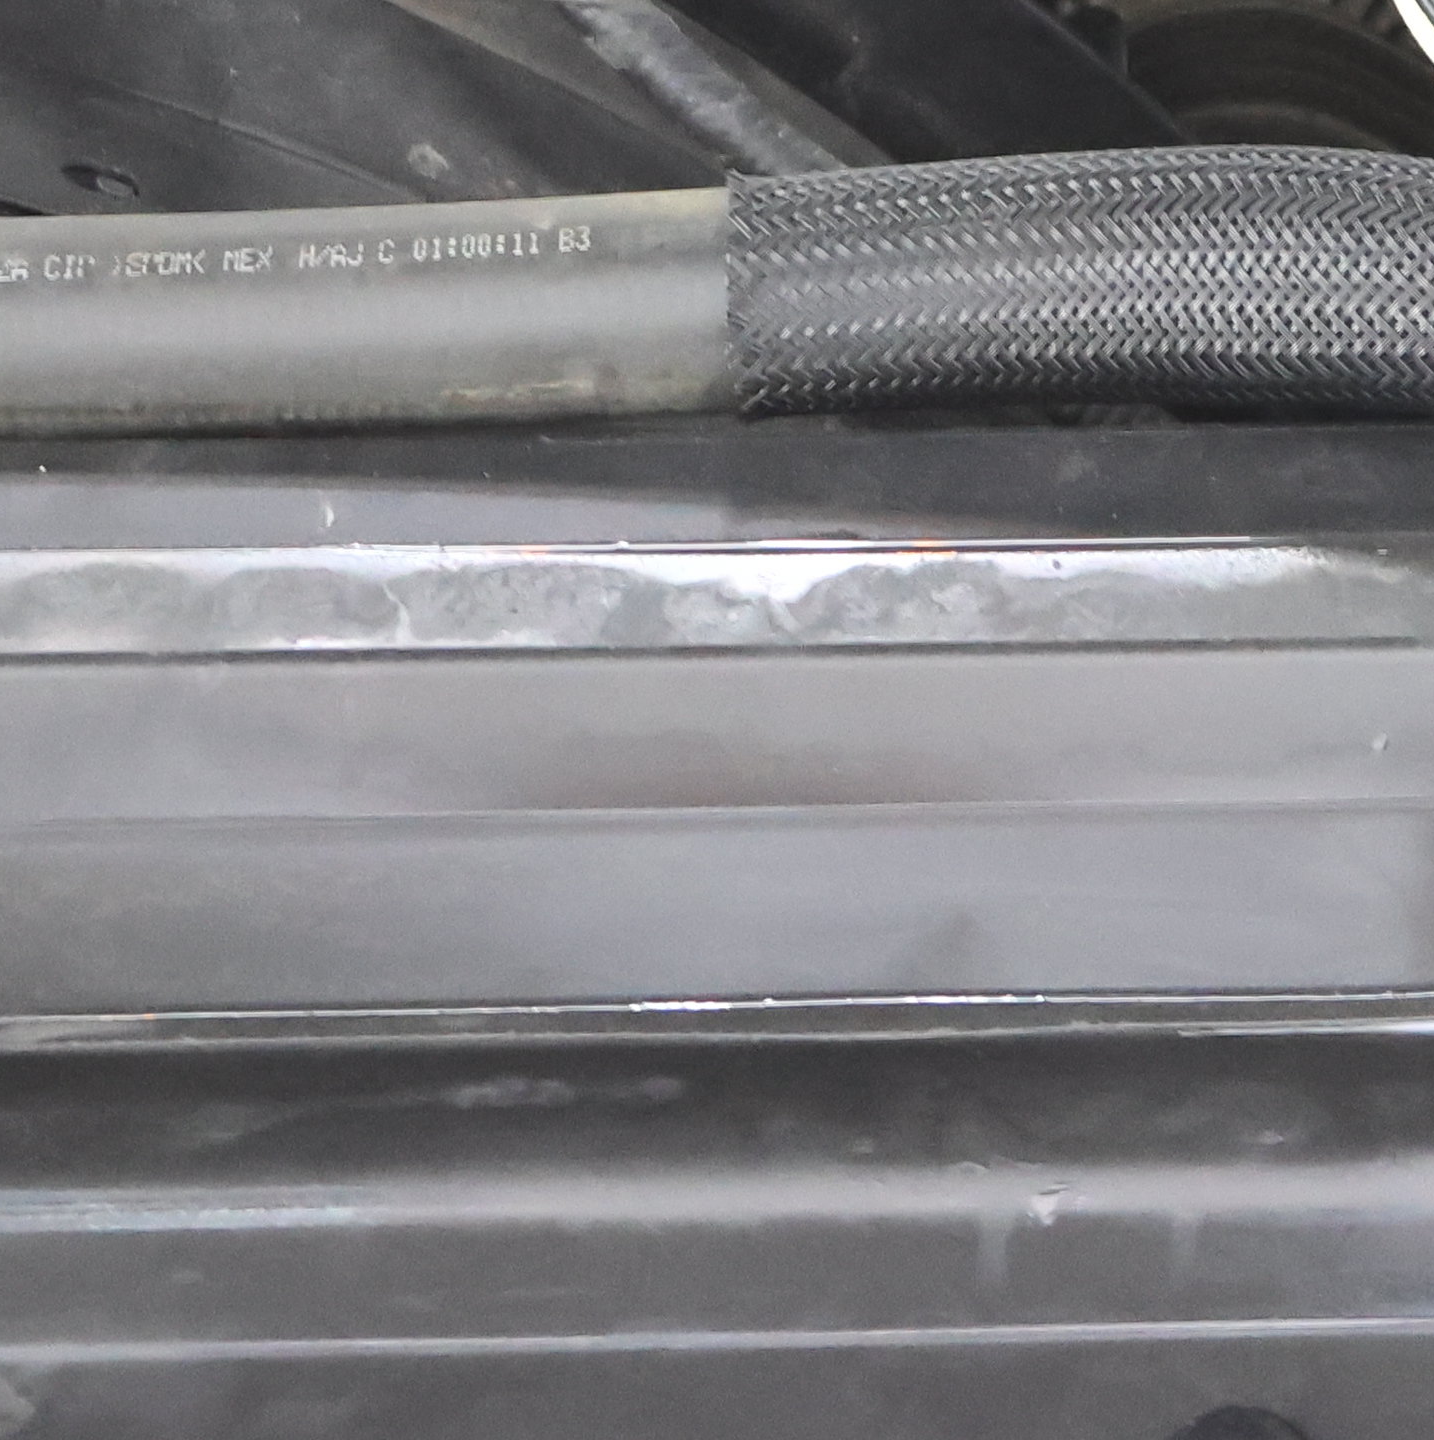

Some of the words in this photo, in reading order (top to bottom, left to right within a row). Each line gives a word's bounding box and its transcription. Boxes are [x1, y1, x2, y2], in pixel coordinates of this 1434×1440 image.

[222, 246, 274, 274] MEX
[412, 230, 540, 263] 01:00:11
[556, 227, 592, 254] B3
